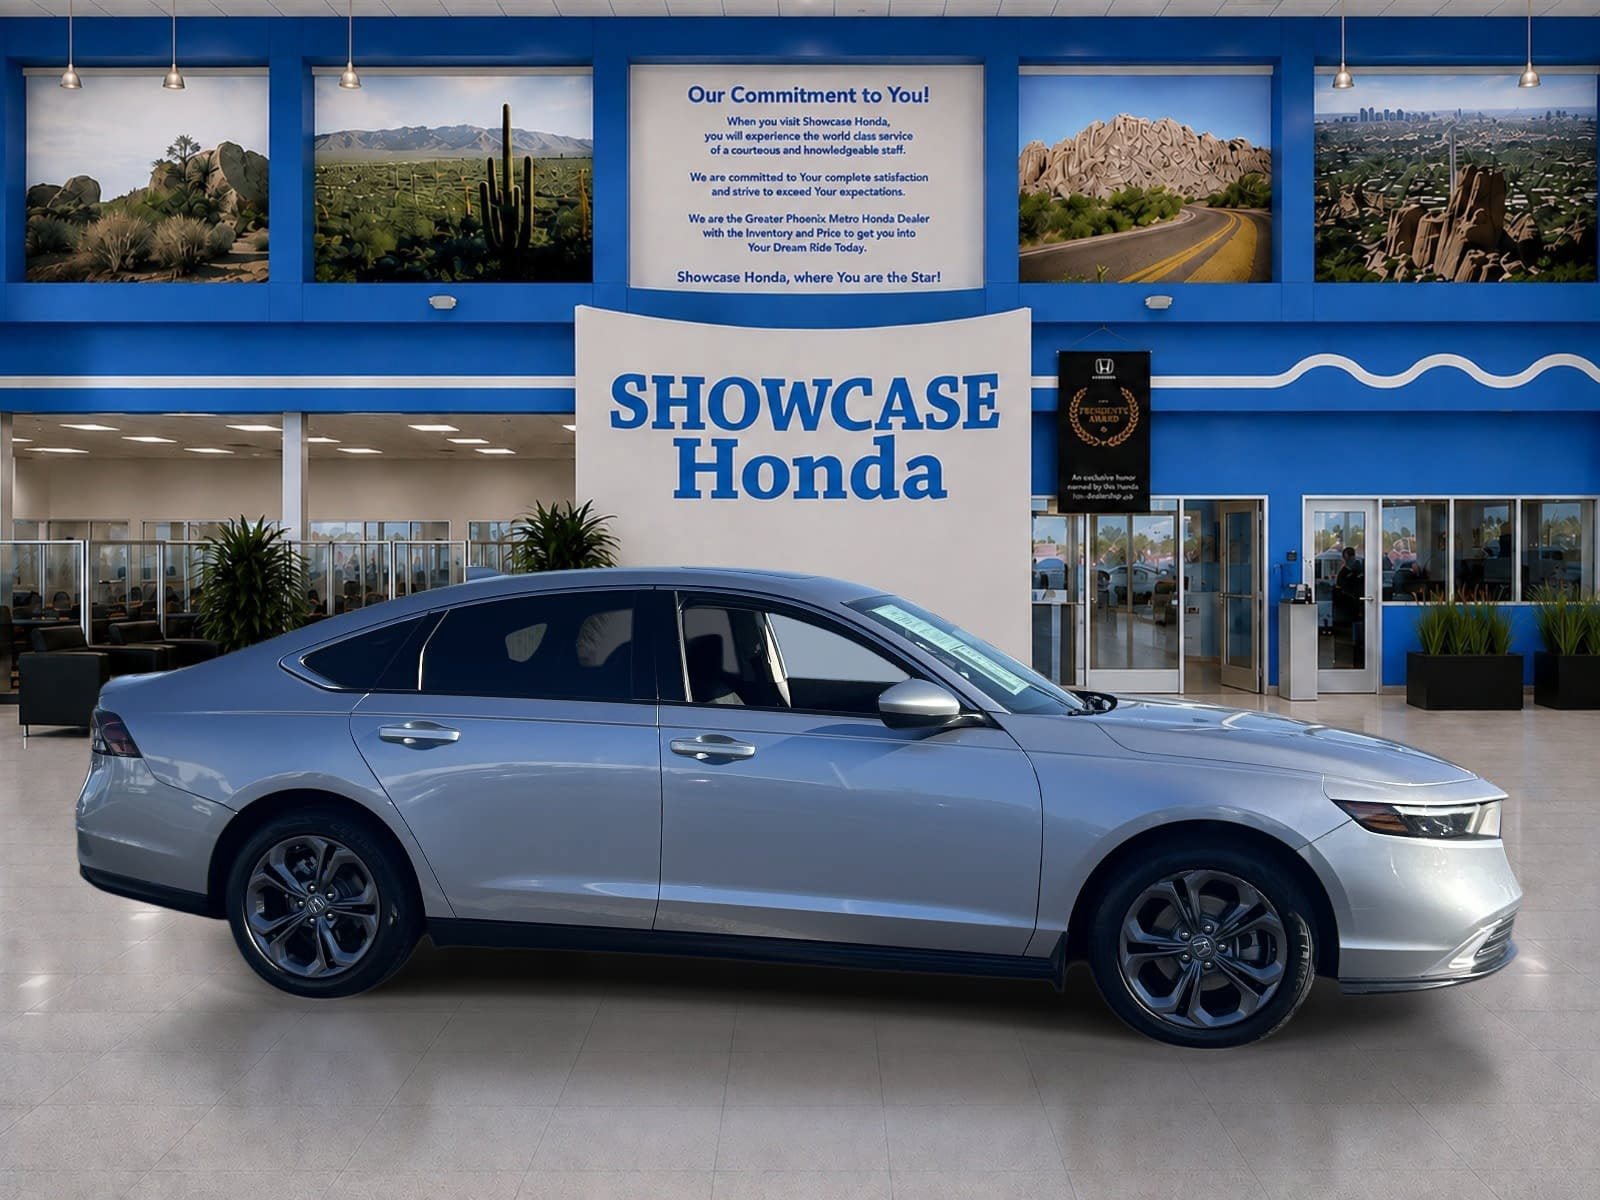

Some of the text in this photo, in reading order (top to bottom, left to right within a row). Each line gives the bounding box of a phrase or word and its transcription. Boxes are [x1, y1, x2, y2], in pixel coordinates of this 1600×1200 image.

[687, 86, 930, 103] Our Commitment to You!
[726, 116, 891, 128] When you visit Showcase Honda,
[704, 131, 914, 143] you will experience the world class service
[710, 145, 722, 154] of
[730, 147, 781, 155] courteous
[782, 145, 802, 154] and
[881, 145, 906, 155] staff.
[689, 172, 708, 182] We
[728, 172, 784, 182] committed
[786, 174, 798, 182] to
[799, 173, 823, 182] Your
[824, 172, 872, 185] complete
[873, 172, 929, 182] satisfaction
[711, 186, 906, 199] and strive to exceed Your expectations.
[688, 214, 706, 223] We
[725, 214, 743, 223] the
[744, 214, 785, 223] Greater
[785, 214, 827, 223] Phoenix
[828, 214, 860, 223] Metro
[861, 214, 895, 223] Honda
[897, 214, 931, 223] Dealer
[702, 228, 917, 240] with the Inventory and Price to get you into
[747, 243, 868, 254] Your Dream Ride Today.
[677, 271, 941, 285] Showcase Honda, where You are the Star!
[611, 373, 999, 431] SHOWCASE
[674, 435, 947, 500] Honda
